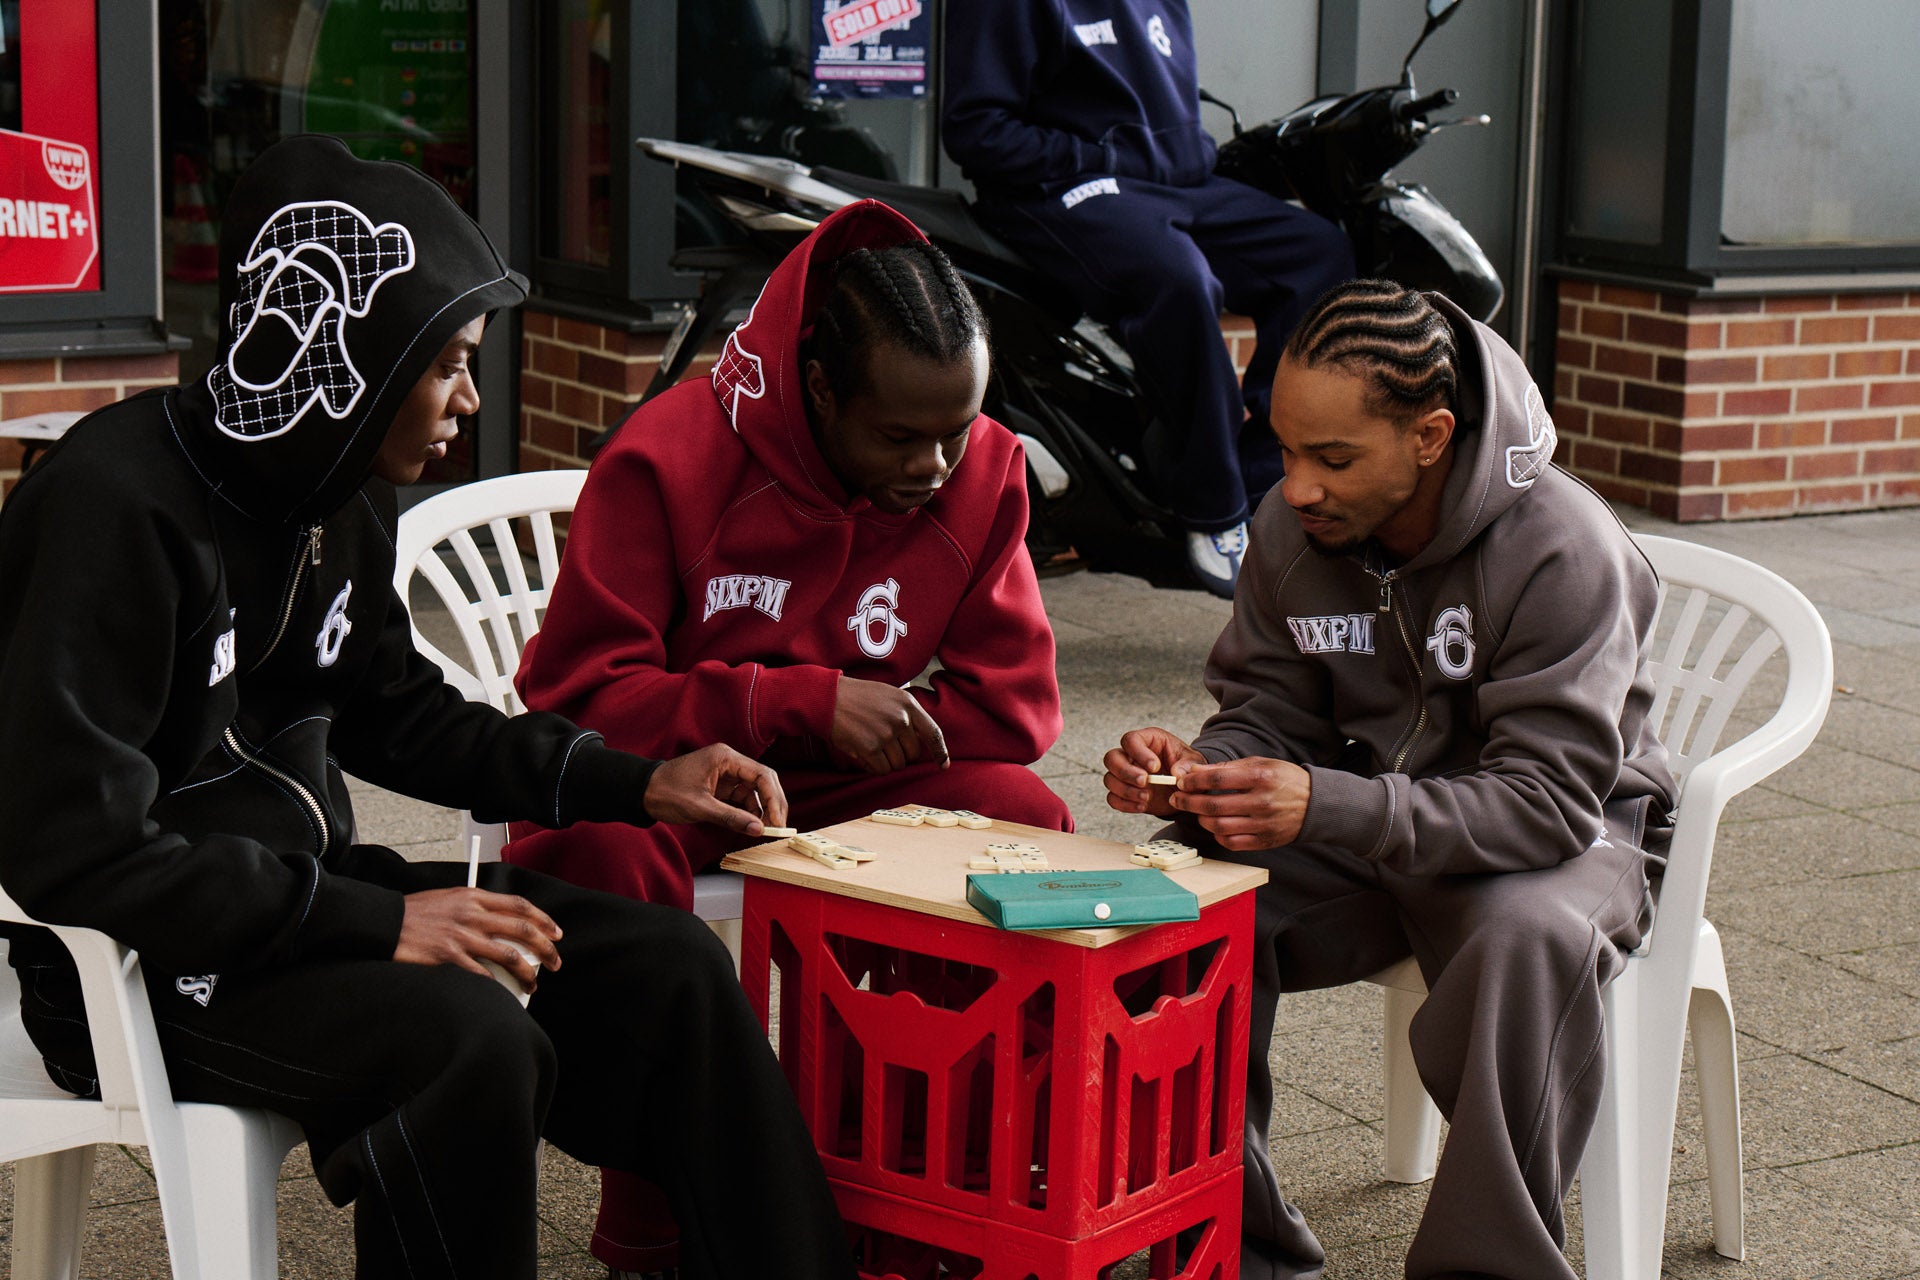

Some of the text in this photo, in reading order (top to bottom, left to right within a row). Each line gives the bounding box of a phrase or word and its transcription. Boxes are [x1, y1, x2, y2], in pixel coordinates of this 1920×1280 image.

[832, 5, 878, 39] SOLD
[703, 574, 792, 622] SIXPM
[1286, 612, 1376, 656] SIXPM
